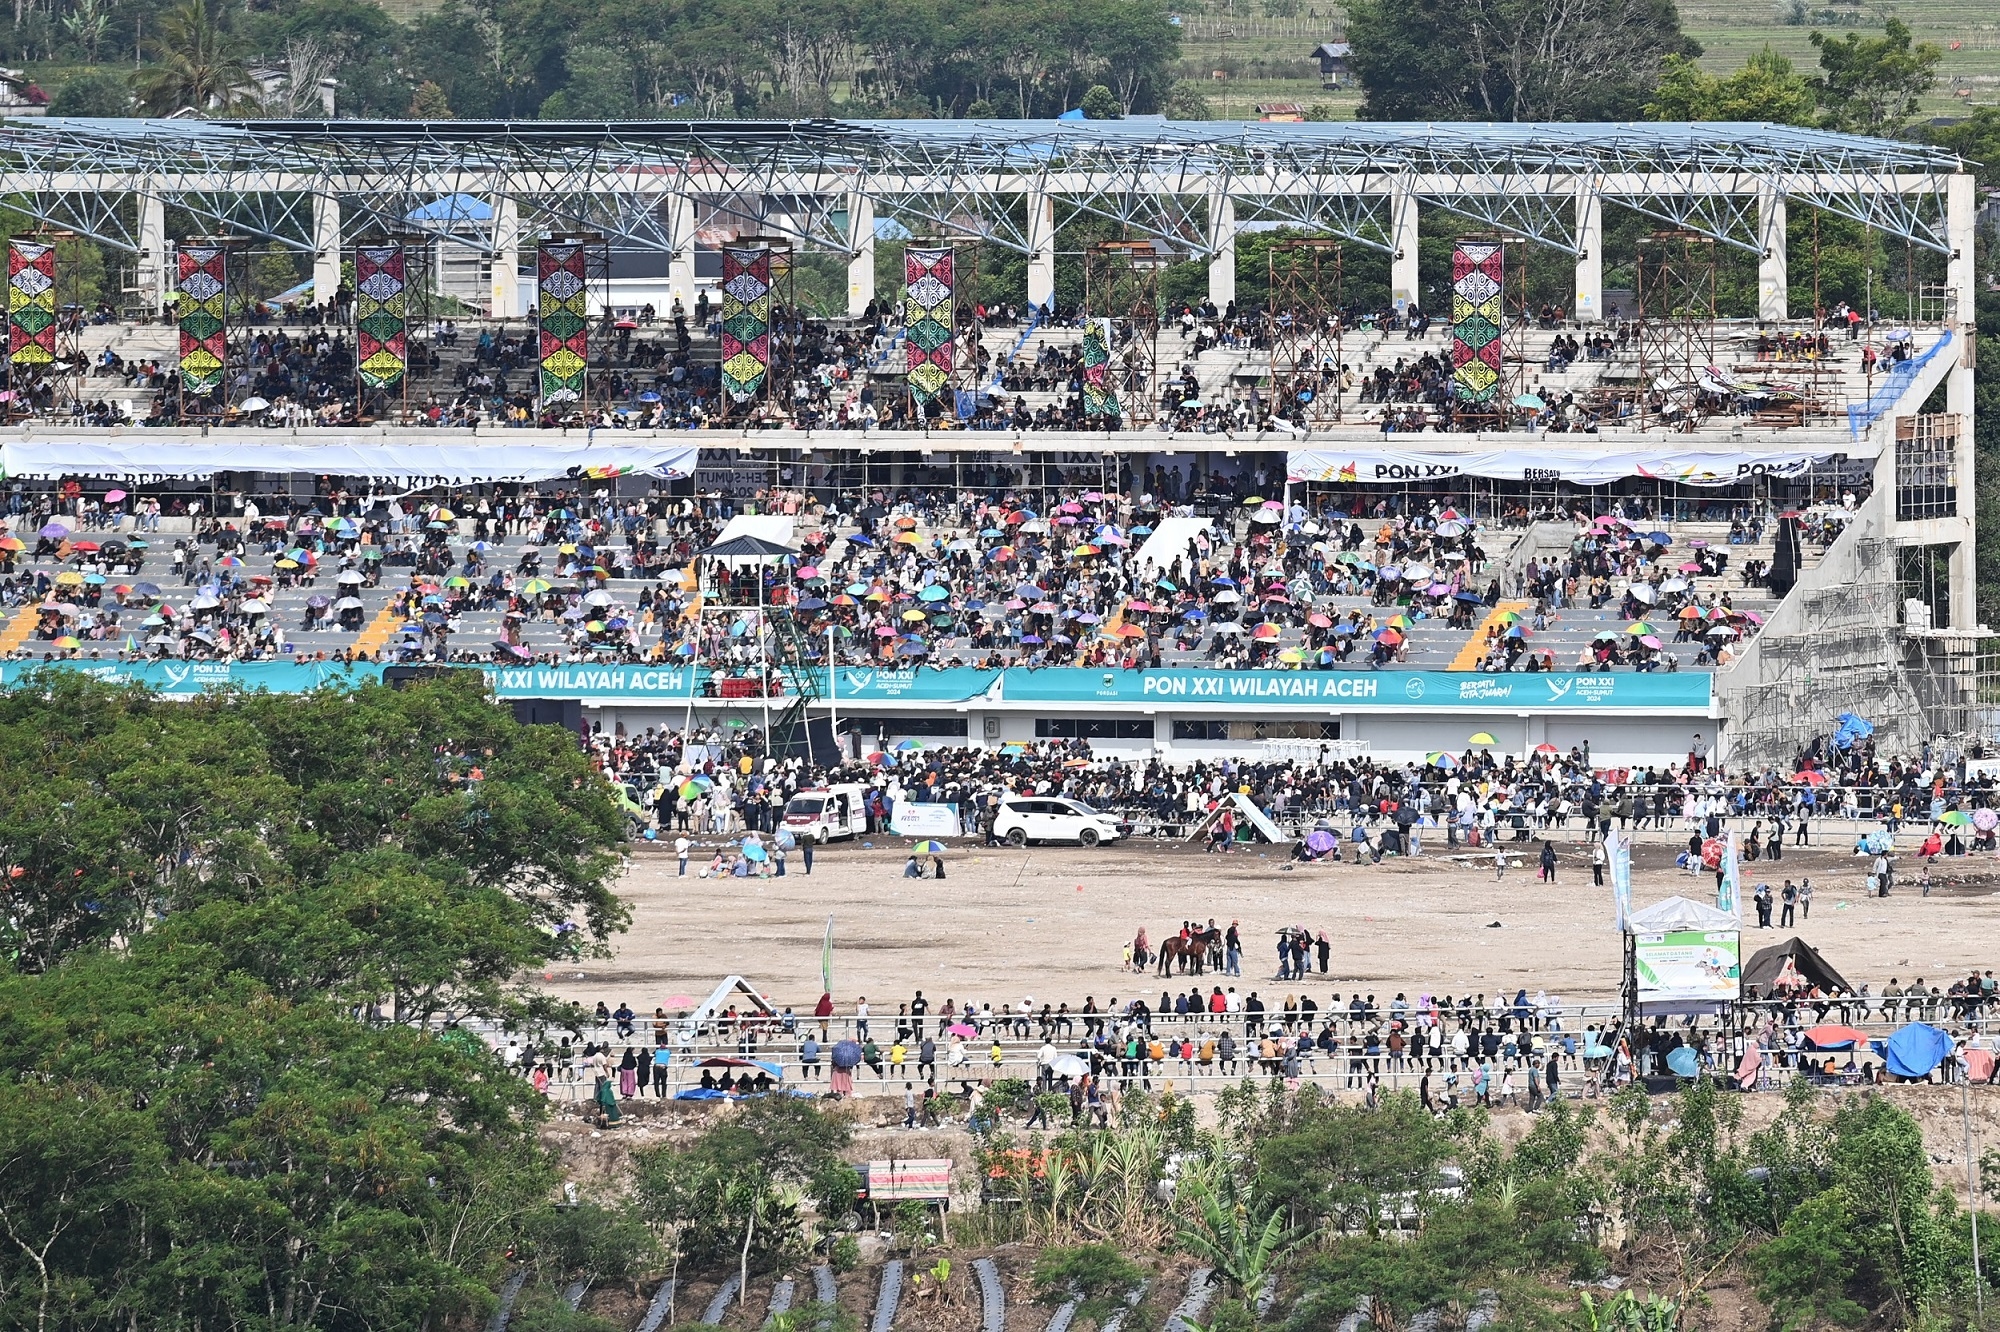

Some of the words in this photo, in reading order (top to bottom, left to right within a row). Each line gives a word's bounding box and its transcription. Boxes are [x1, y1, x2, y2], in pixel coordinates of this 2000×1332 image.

[1376, 464, 1420, 478] PON
[193, 665, 213, 673] PON
[214, 665, 230, 673] XXI
[502, 671, 533, 689] XXI
[538, 672, 625, 690] WILAYAH
[629, 672, 683, 690] ACEH
[876, 671, 897, 679] PON
[898, 671, 914, 679] XXI
[1143, 676, 1185, 695] PON
[1191, 677, 1224, 696] XXI
[1229, 678, 1318, 697] WILAYAH
[1323, 679, 1378, 697] ACEH
[1576, 678, 1597, 686] PON
[1598, 678, 1615, 686] XXI
